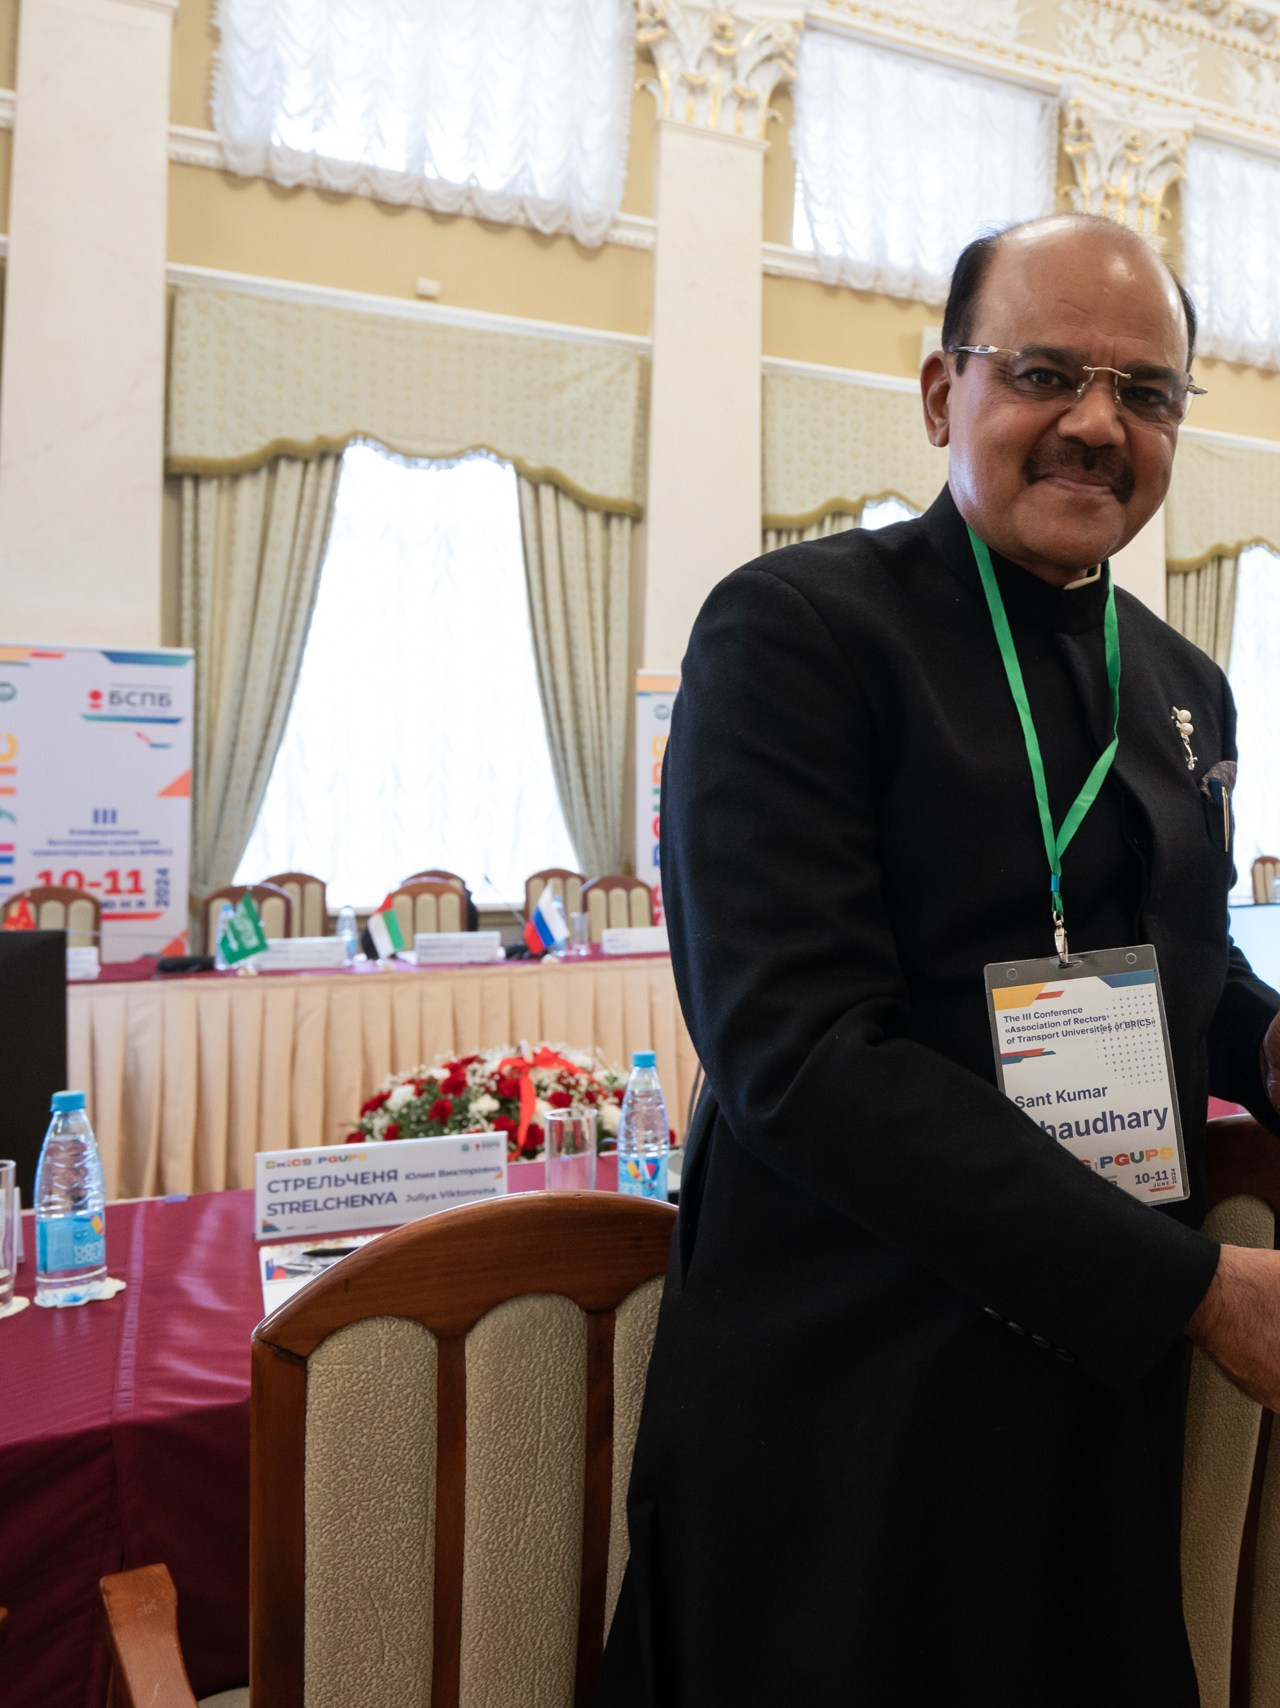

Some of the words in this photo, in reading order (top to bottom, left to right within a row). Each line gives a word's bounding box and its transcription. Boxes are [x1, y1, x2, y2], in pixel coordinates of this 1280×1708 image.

[109, 690, 172, 707] БСПБ
[37, 869, 145, 894] 10-11
[1003, 1015, 1020, 1023] The
[1033, 1006, 1083, 1019] Conference
[1005, 1020, 1062, 1033] «Association
[1063, 1018, 1071, 1026] of
[1073, 1014, 1107, 1025] Rectors
[1006, 1036, 1015, 1045] of
[1016, 1032, 1059, 1044] Transport
[1061, 1024, 1111, 1037] Universities
[1114, 1022, 1123, 1030] of
[1014, 1091, 1052, 1109] Sant
[1056, 1084, 1108, 1104] Kumar
[1040, 1106, 1168, 1141] haudhary
[1100, 1146, 1173, 1169] PGUPS
[267, 1169, 398, 1194] СТРЕЛЬЧЕНЯ
[405, 1171, 436, 1181] Юлия
[438, 1165, 500, 1179] Викторовна
[1135, 1170, 1169, 1184] 10-11
[266, 1191, 398, 1216] STRELCHENYA
[440, 1186, 497, 1198] Viktorovna
